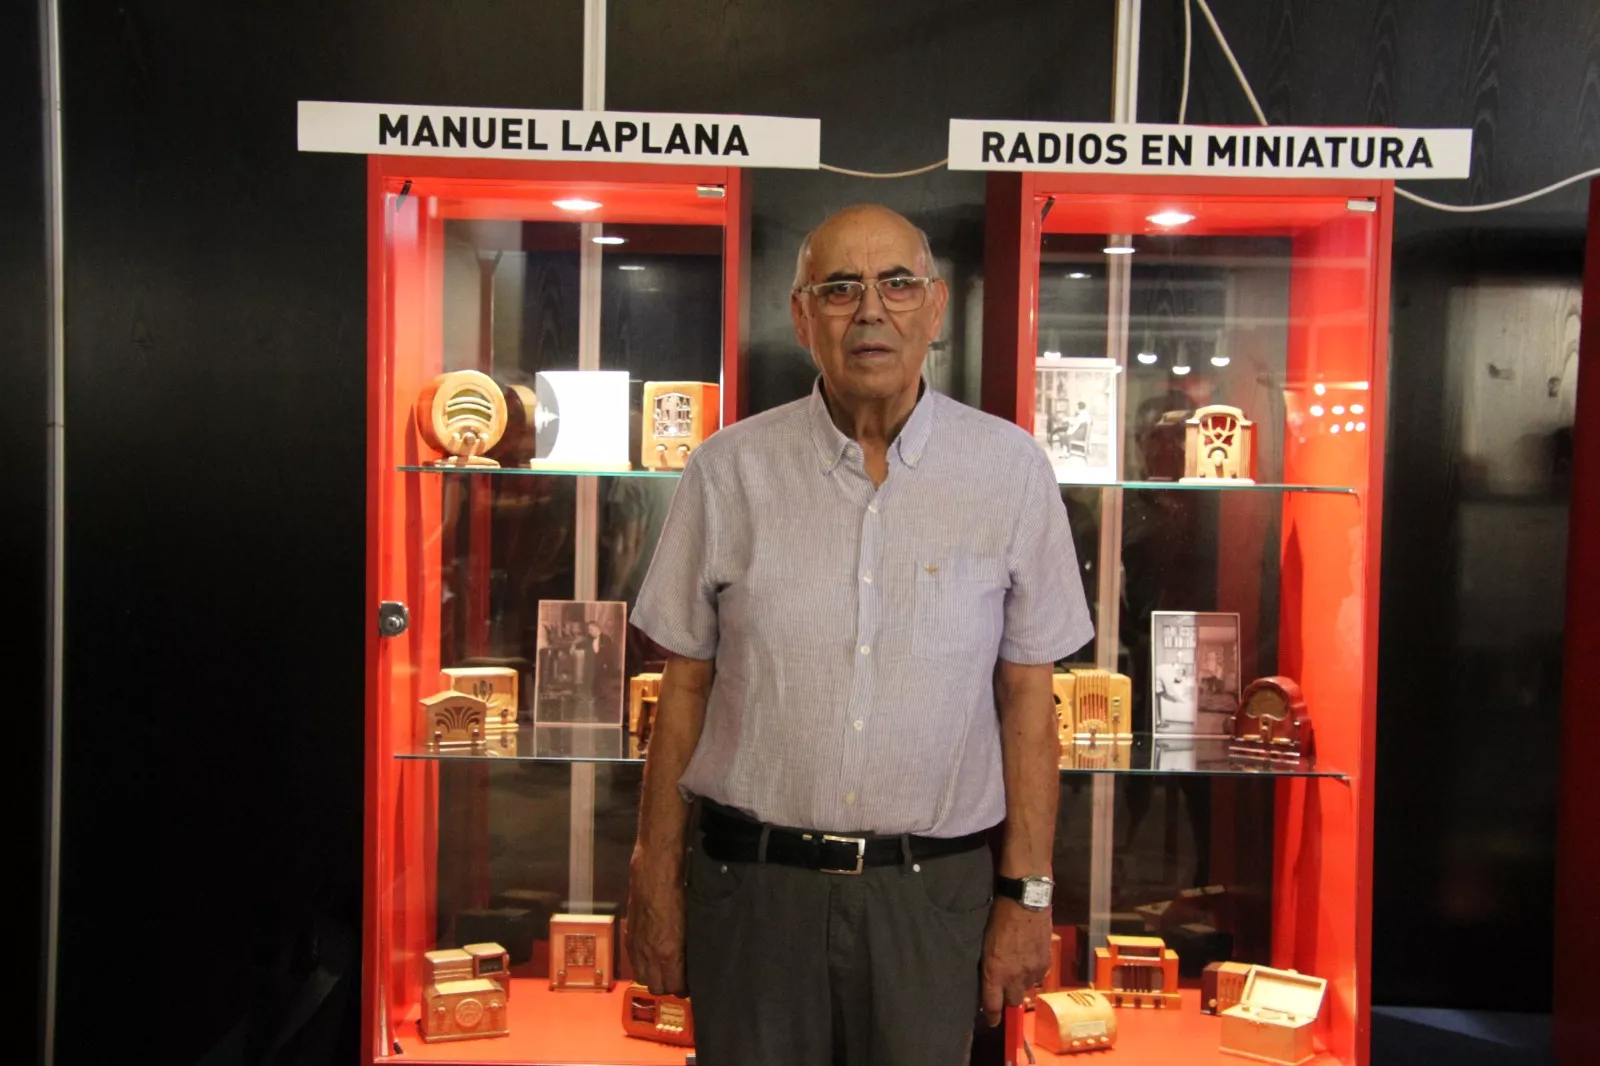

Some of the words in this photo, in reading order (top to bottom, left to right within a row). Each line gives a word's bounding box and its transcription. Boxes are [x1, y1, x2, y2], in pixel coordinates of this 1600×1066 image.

[378, 113, 549, 151] MANUEL
[561, 119, 750, 157] LAPLANA
[981, 131, 1128, 166] RADIOS
[1141, 134, 1193, 166] EN
[1207, 135, 1433, 169] MINIATURA
